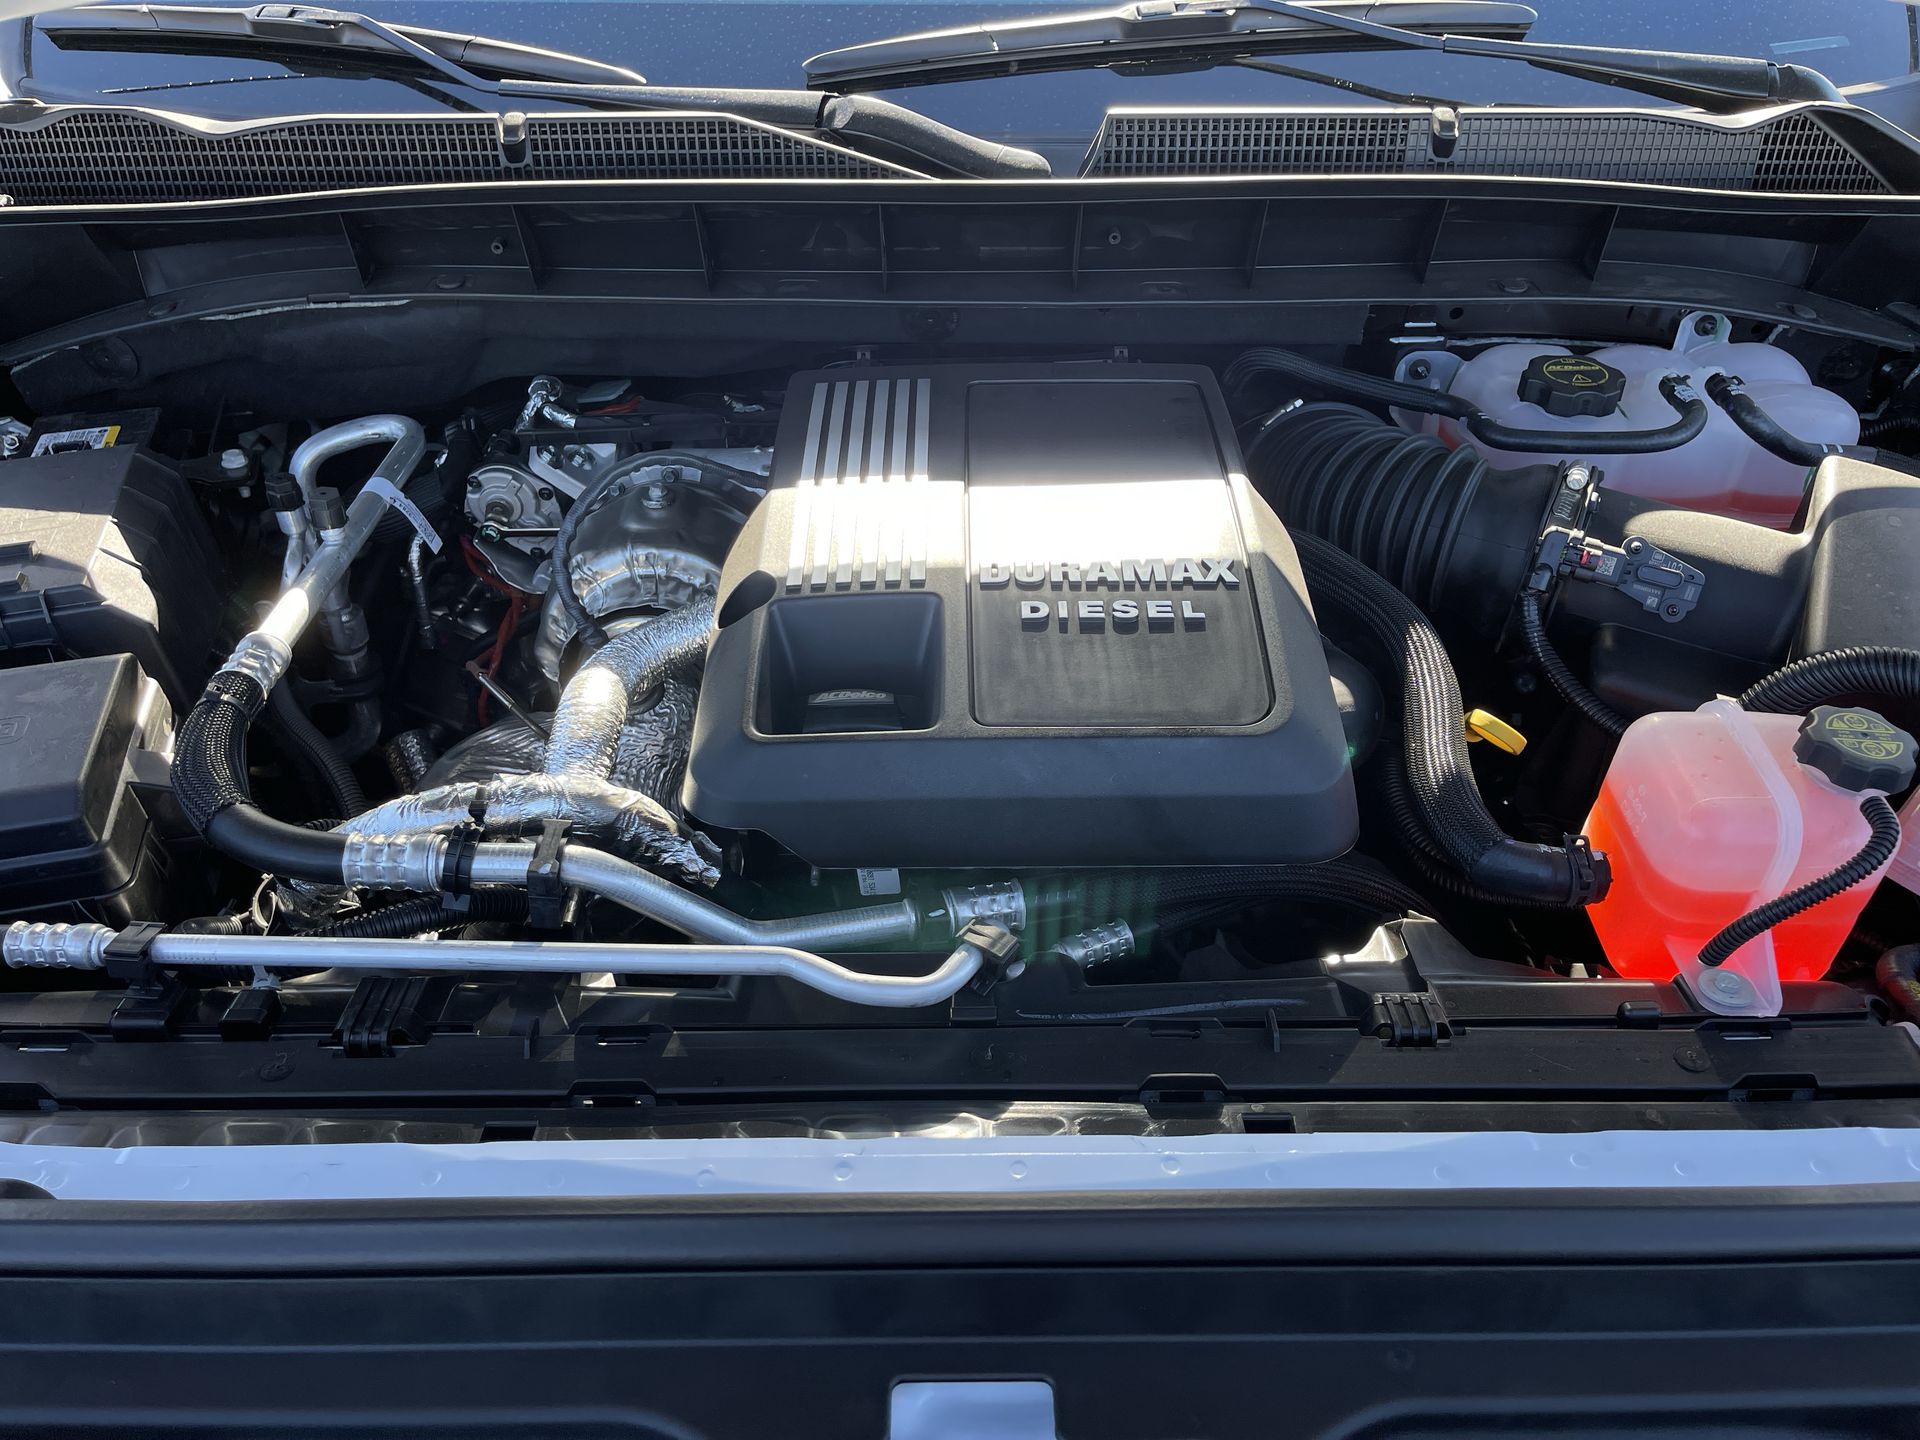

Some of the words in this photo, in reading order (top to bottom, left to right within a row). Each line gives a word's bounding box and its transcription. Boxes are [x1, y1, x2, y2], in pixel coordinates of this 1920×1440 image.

[979, 558, 1240, 588] DURAMAX
[1020, 600, 1206, 623] DIESEL
[814, 691, 887, 703] ACDelco
